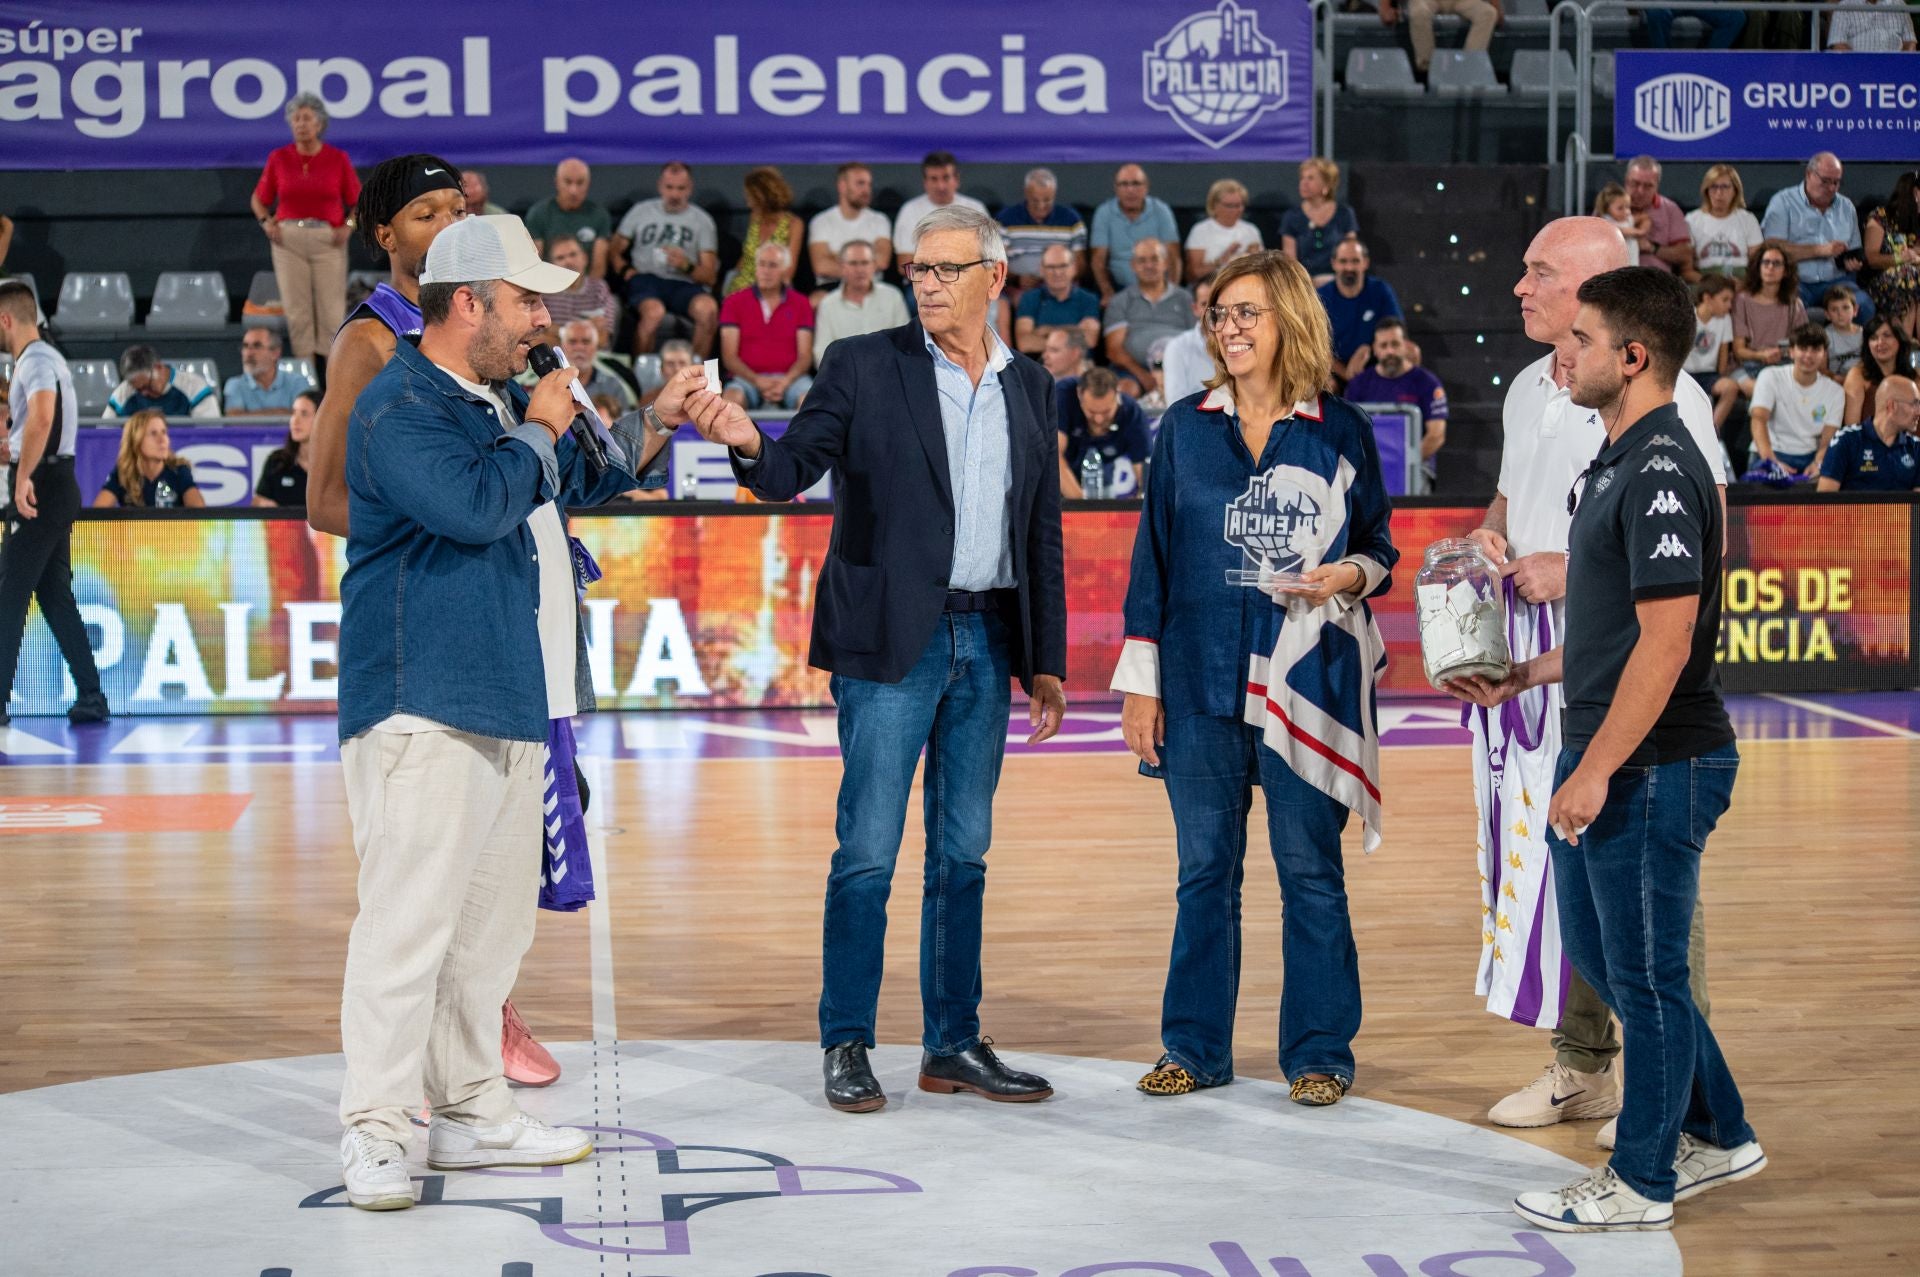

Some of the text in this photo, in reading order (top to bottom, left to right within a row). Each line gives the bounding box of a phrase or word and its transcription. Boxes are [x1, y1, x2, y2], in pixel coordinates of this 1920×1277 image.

[0, 20, 142, 60] súper
[0, 35, 1109, 138] agropal palencia
[1150, 58, 1281, 96] PALENCIA
[1743, 82, 1918, 109] GRUPO TEC
[1639, 79, 1727, 134] TECNIPEC
[641, 222, 693, 246] GAP
[1722, 566, 1853, 613] OS DE
